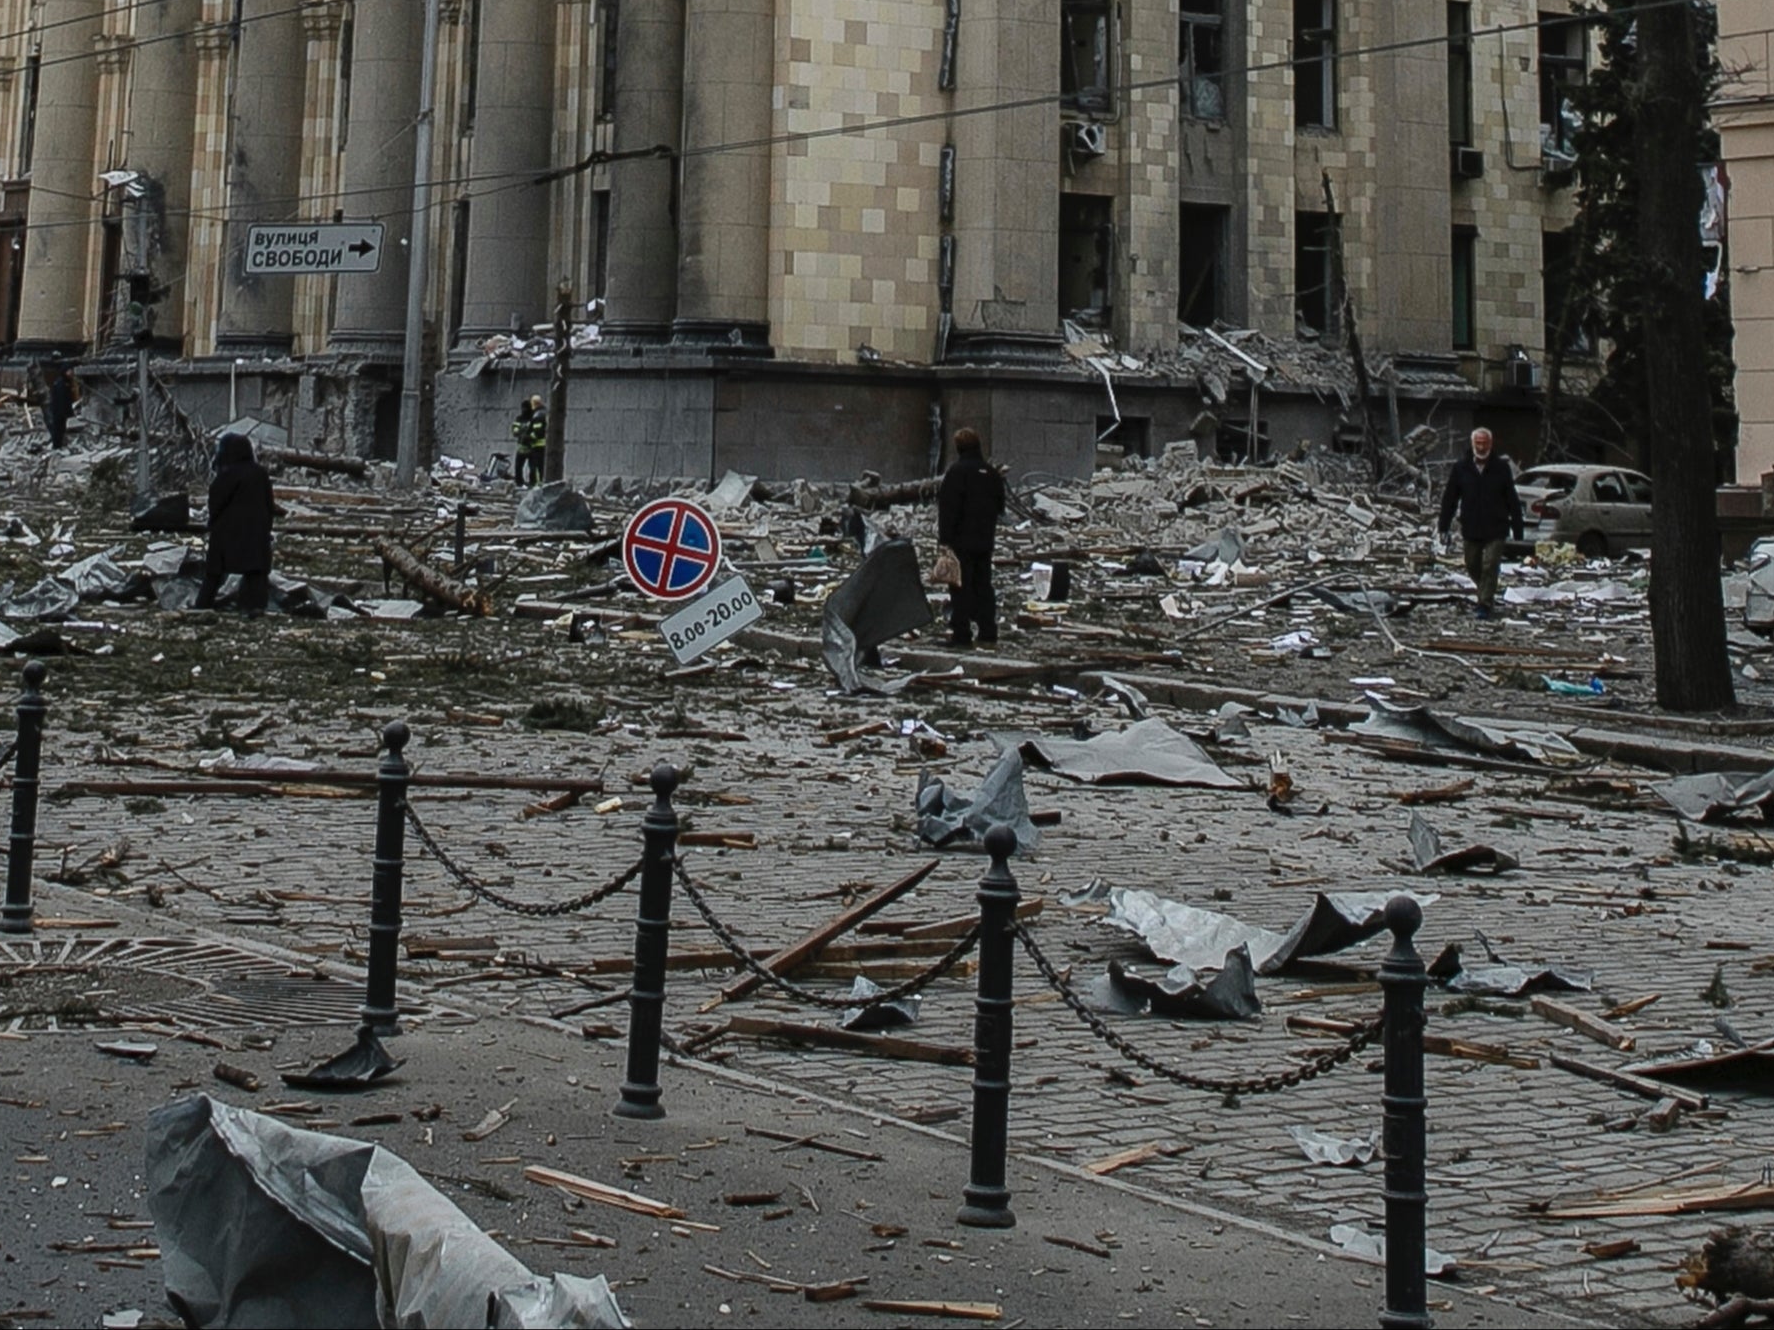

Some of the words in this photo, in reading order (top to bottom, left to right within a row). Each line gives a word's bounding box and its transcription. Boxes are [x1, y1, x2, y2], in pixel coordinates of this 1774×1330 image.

[254, 229, 319, 249] вулиця
[252, 248, 343, 269] СВОБОДИ
[669, 591, 753, 651] 8.00-20.00
